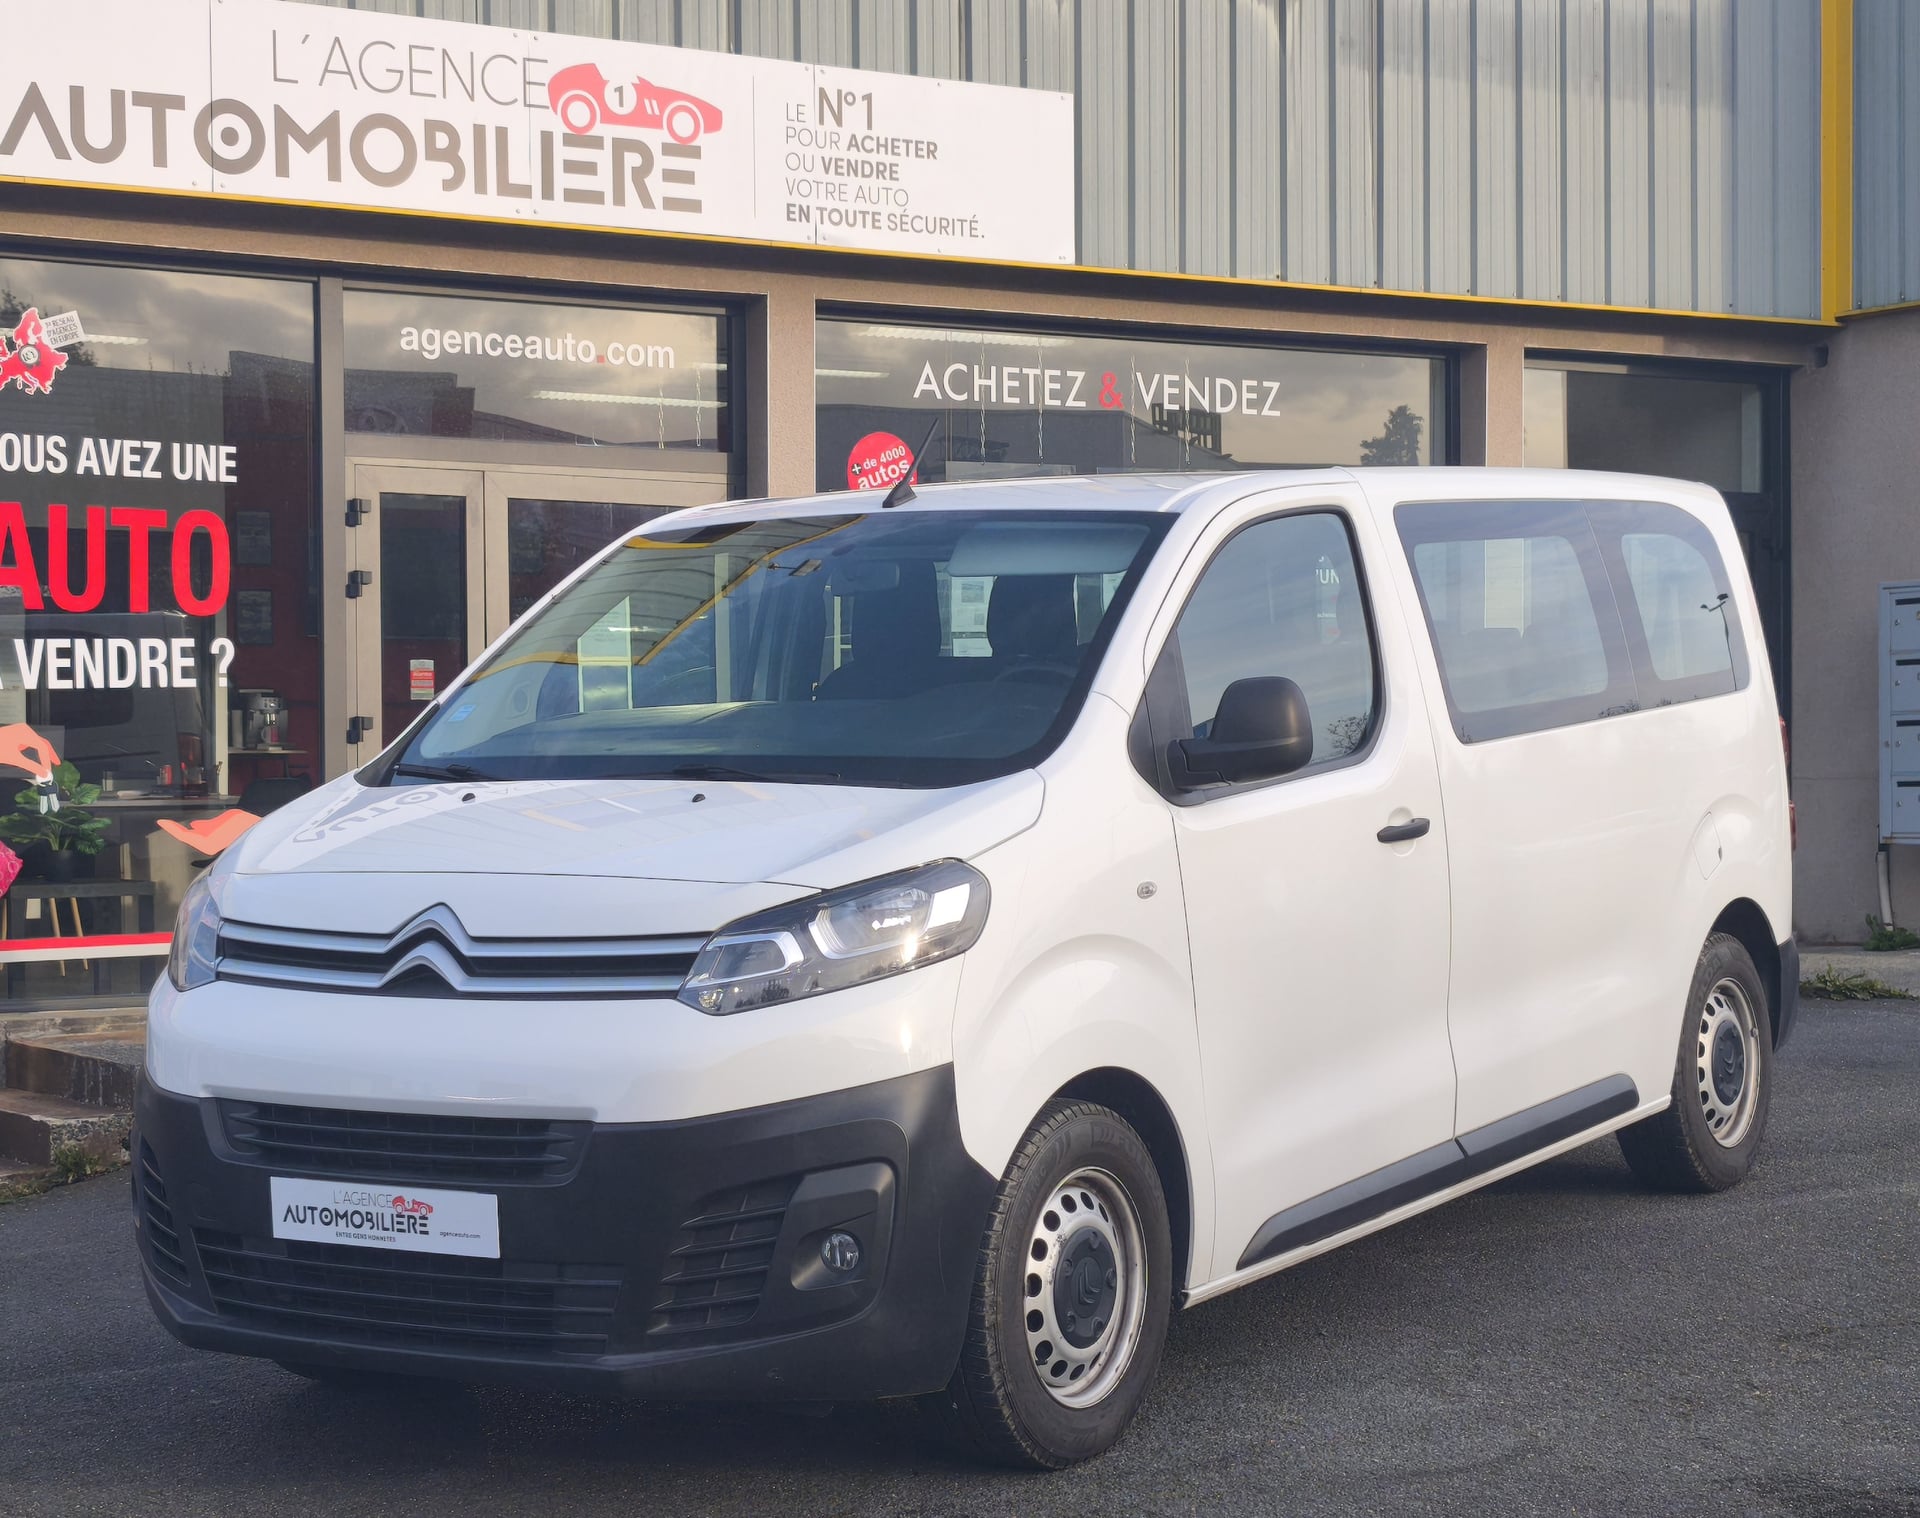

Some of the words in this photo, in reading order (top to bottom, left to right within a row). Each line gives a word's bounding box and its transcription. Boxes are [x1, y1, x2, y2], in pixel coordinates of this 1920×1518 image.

[272, 28, 550, 110] L'AGENCE
[613, 85, 626, 109] 1
[786, 101, 806, 123] LE
[818, 86, 873, 131] N°1
[785, 125, 841, 151] POUR
[846, 132, 938, 160] ACHETER
[785, 152, 815, 173] OU
[821, 155, 900, 182] VENDRE
[785, 177, 848, 202] VOTRE
[854, 184, 909, 207] AUTO
[786, 202, 811, 223] EN
[816, 206, 882, 230] TOUTE
[887, 208, 985, 239] SÉCURITÉ.
[400, 326, 675, 369] agenceauto.com
[913, 360, 1087, 408] ACHETEZ
[1098, 371, 1124, 409] &
[1136, 372, 1281, 417] VENDEZ
[76, 437, 162, 479] AVEZ
[171, 442, 238, 483] UNE
[858, 459, 910, 489] autos
[863, 458, 877, 470] de
[880, 445, 906, 464] 4000
[0, 501, 231, 617] AUTO
[14, 638, 197, 690] VENDRE
[210, 637, 235, 688] ?
[333, 1190, 393, 1209] L'AGENCE
